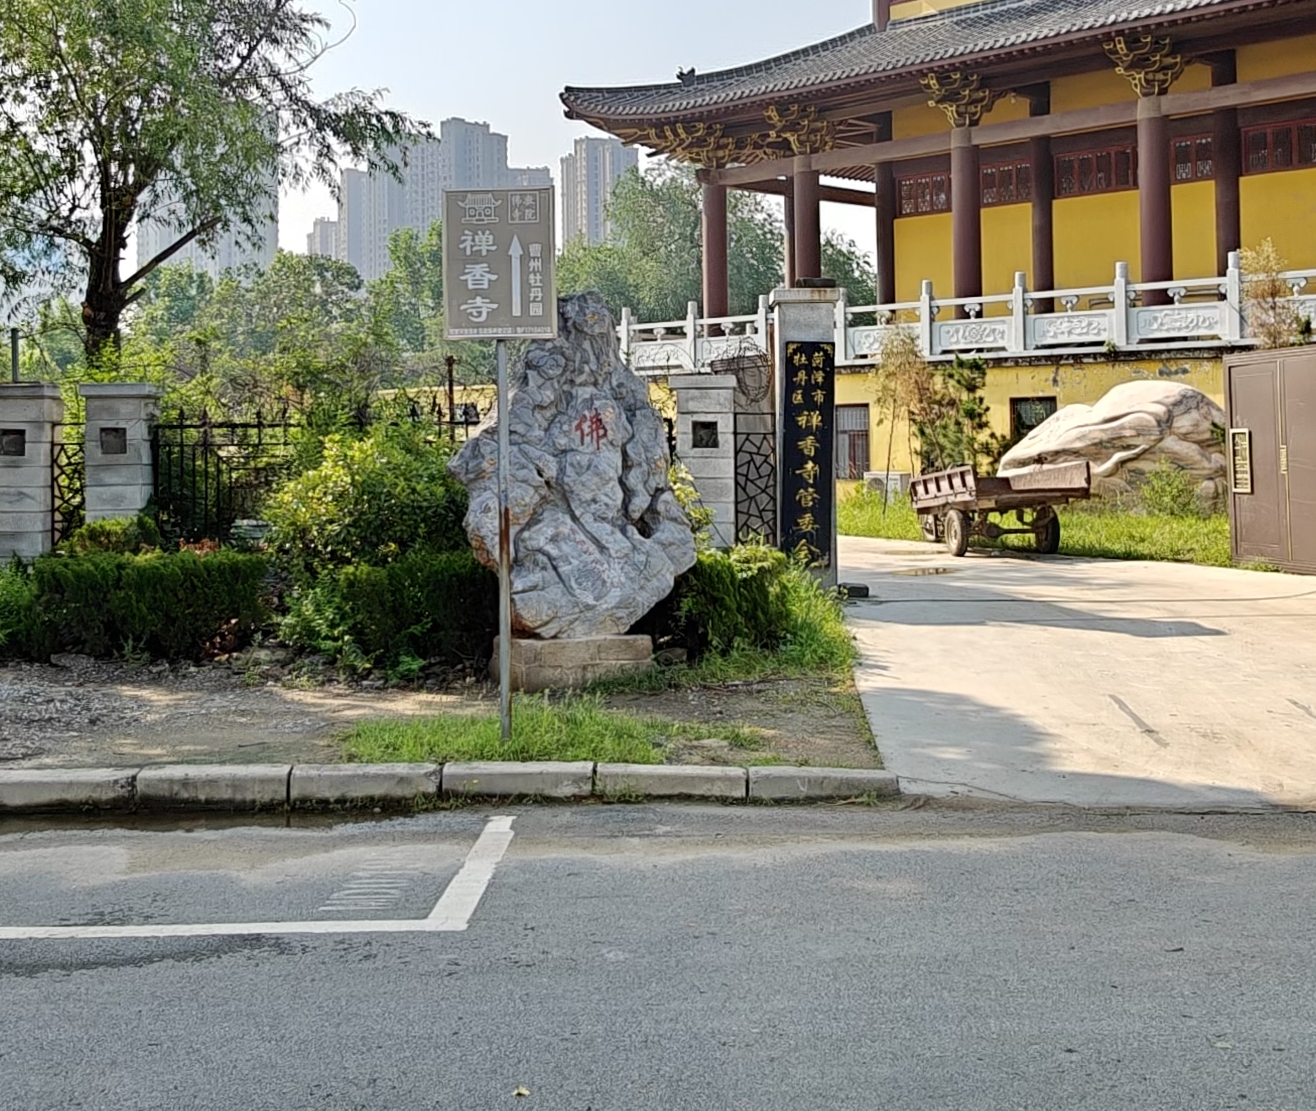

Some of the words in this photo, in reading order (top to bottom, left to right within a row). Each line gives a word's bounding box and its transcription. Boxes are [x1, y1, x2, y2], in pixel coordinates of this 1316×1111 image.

[459, 229, 500, 323] 禅香寺
[528, 243, 543, 317] 曹州牡丹园
[792, 353, 808, 404] 牡丹区
[810, 352, 826, 406] 菏泽市
[574, 407, 608, 450] 佛
